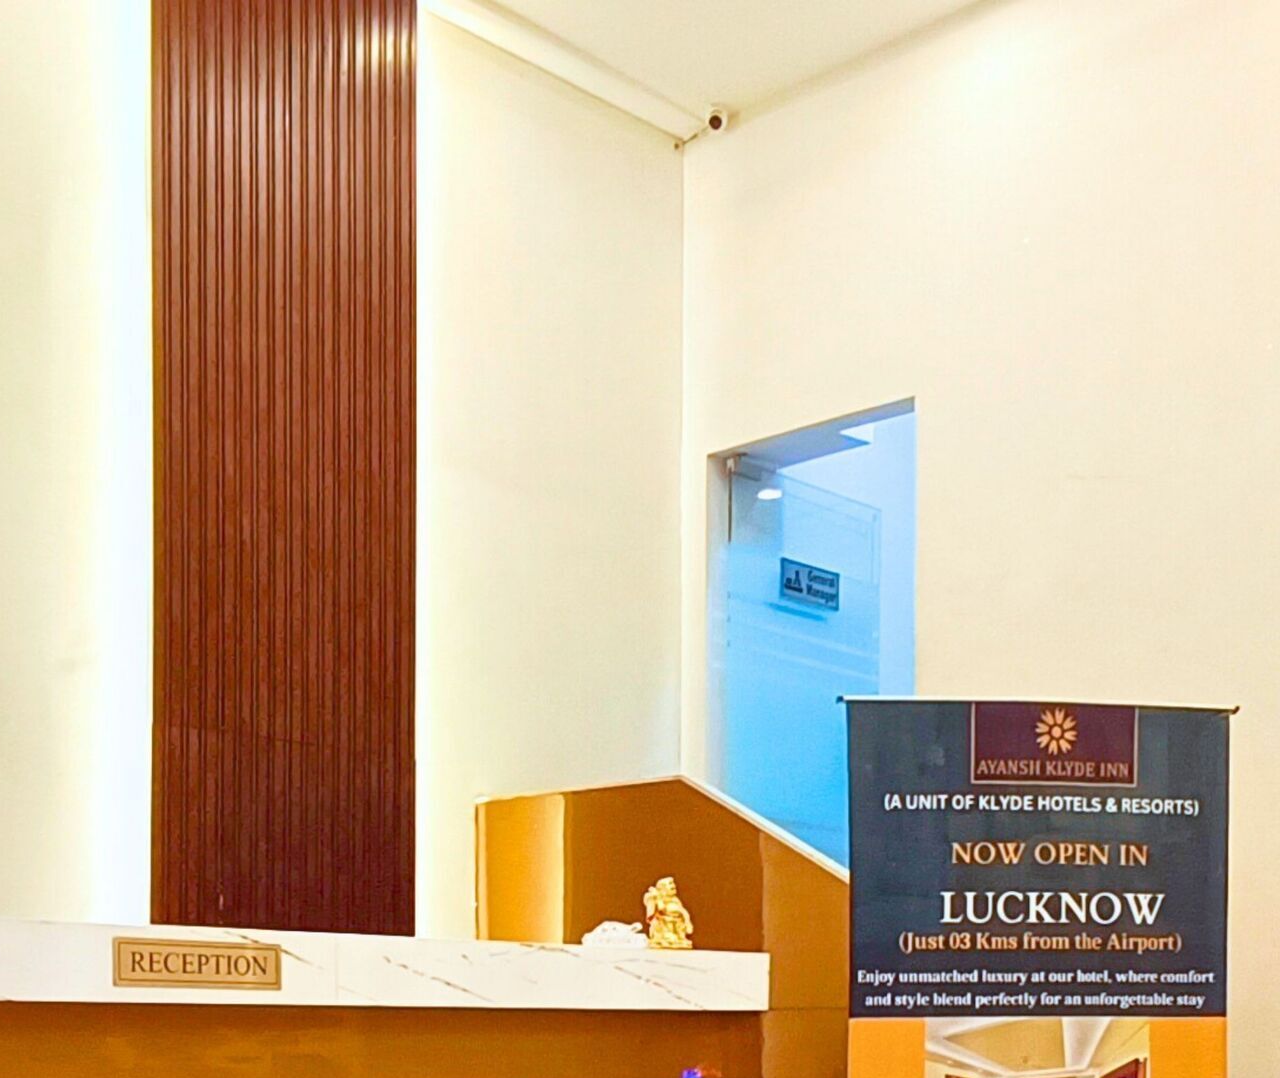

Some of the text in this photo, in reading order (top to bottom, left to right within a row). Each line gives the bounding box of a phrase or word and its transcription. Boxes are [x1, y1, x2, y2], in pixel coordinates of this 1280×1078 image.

[976, 761, 1129, 778] AYANSH KLYDE INN
[884, 794, 1199, 816] (A UNIT OF KLYDE HOTELS & RESORTS)
[951, 842, 1149, 866] NOW OPEN IN
[940, 891, 1165, 925] LUCKNOW
[899, 932, 1182, 954] (Just 03 Kms from the Airport)
[130, 952, 268, 976] RECEPTION
[857, 969, 1215, 986] Enjoy unmatched luxury at our hotel, where comfort
[865, 992, 1205, 1009] and style blend perfectly for an unforgettable stay
